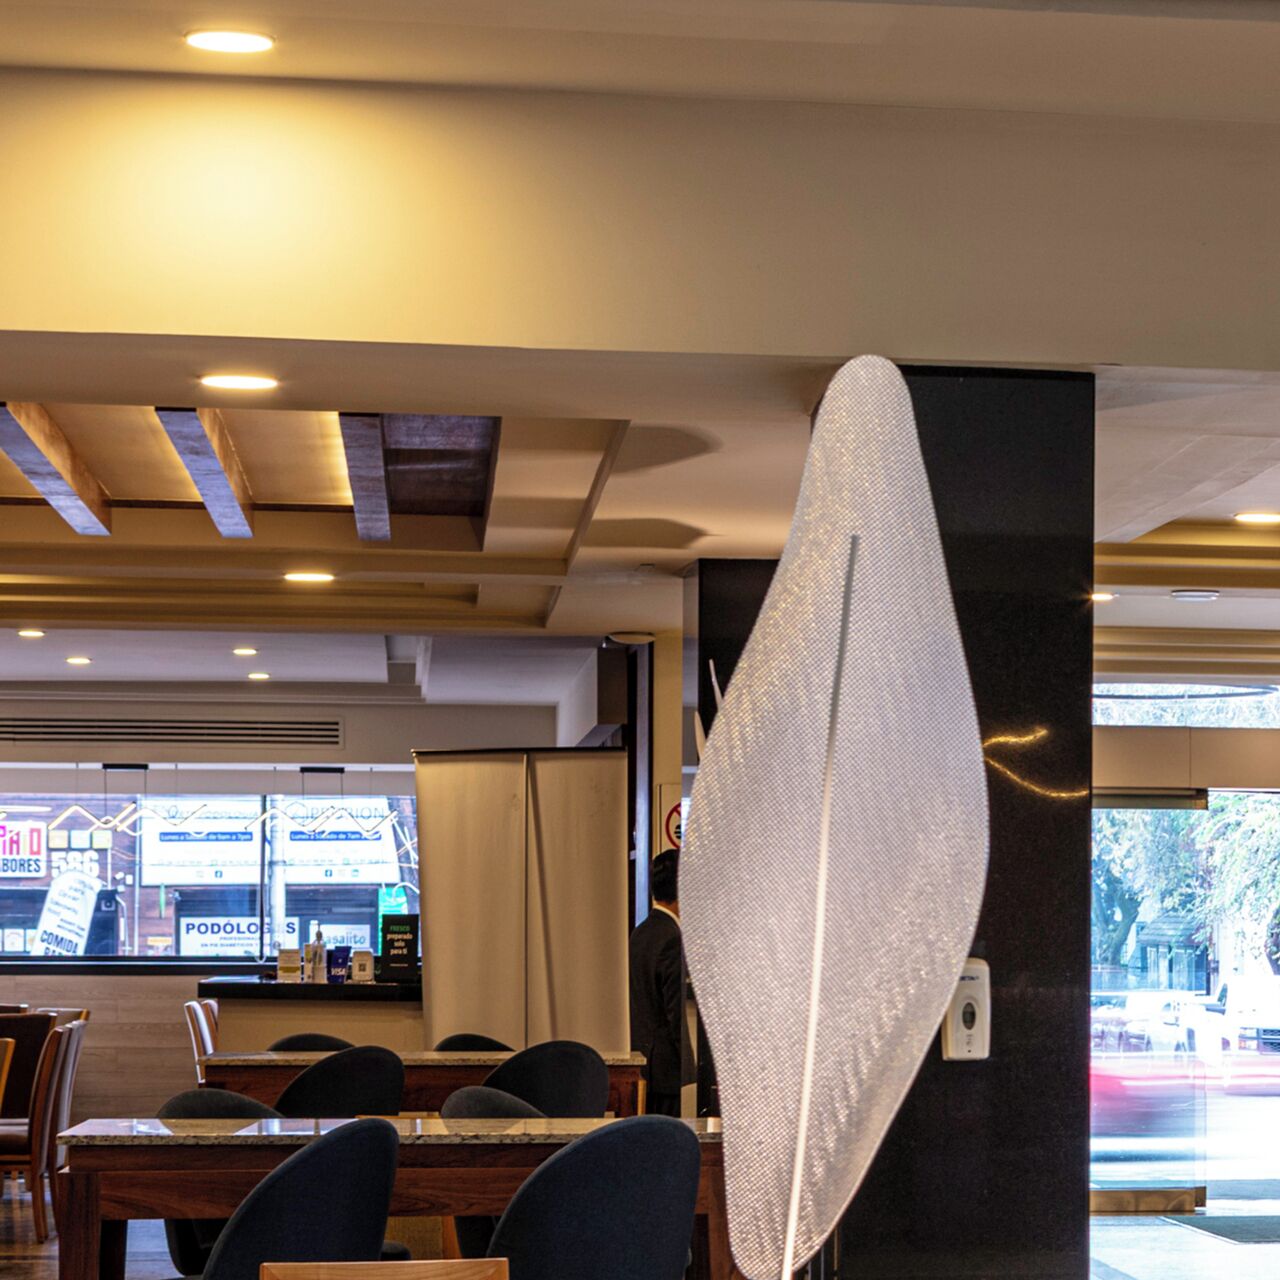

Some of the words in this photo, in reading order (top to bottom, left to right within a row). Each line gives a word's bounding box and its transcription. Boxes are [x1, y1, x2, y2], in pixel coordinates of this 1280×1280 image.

[0, 858, 41, 874] BORES
[185, 919, 297, 935] PODÓLOGS
[326, 931, 366, 946] asajito
[331, 967, 346, 976] VISA
